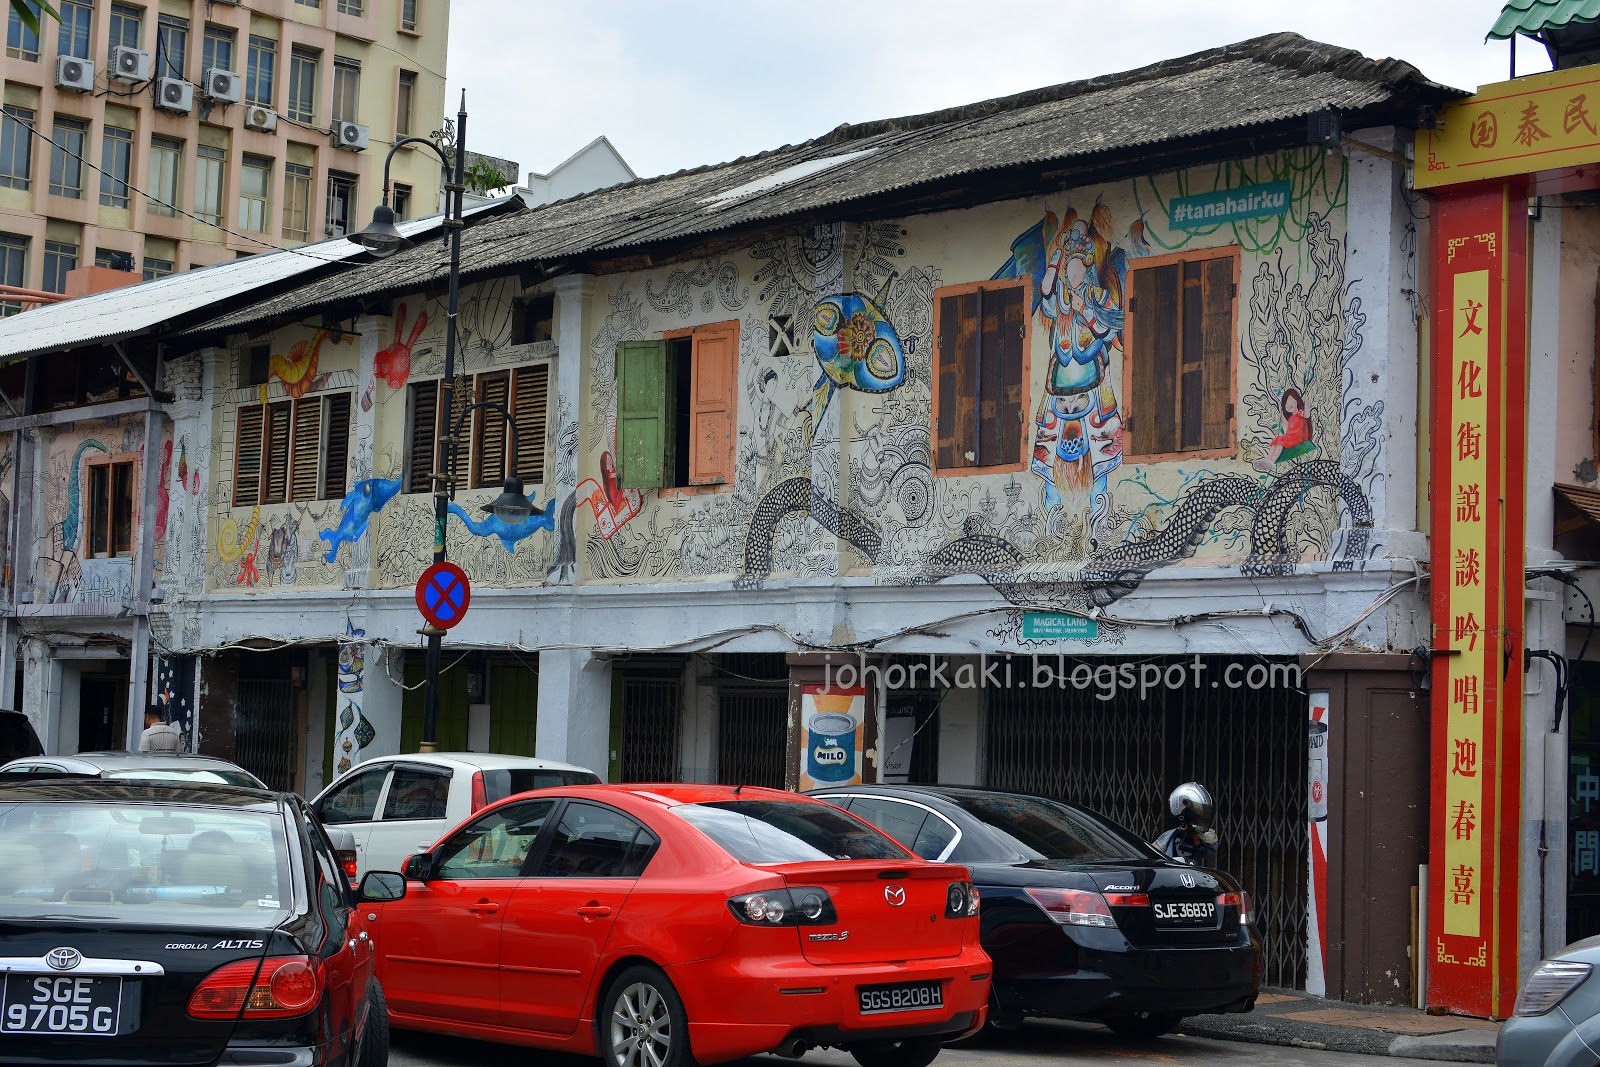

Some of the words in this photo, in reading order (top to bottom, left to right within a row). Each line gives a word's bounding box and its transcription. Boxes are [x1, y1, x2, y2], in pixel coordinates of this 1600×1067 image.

[1174, 190, 1285, 223] #tanahairku
[1033, 617, 1066, 627] MAGICAL
[1067, 617, 1088, 627] LAND
[817, 751, 844, 760] MILO
[1153, 902, 1215, 919] SJE3683P
[212, 939, 264, 949] ALTIS
[32, 976, 94, 1004] SGE
[861, 986, 942, 1010] SGS8208H
[6, 1003, 113, 1032] 9705G
